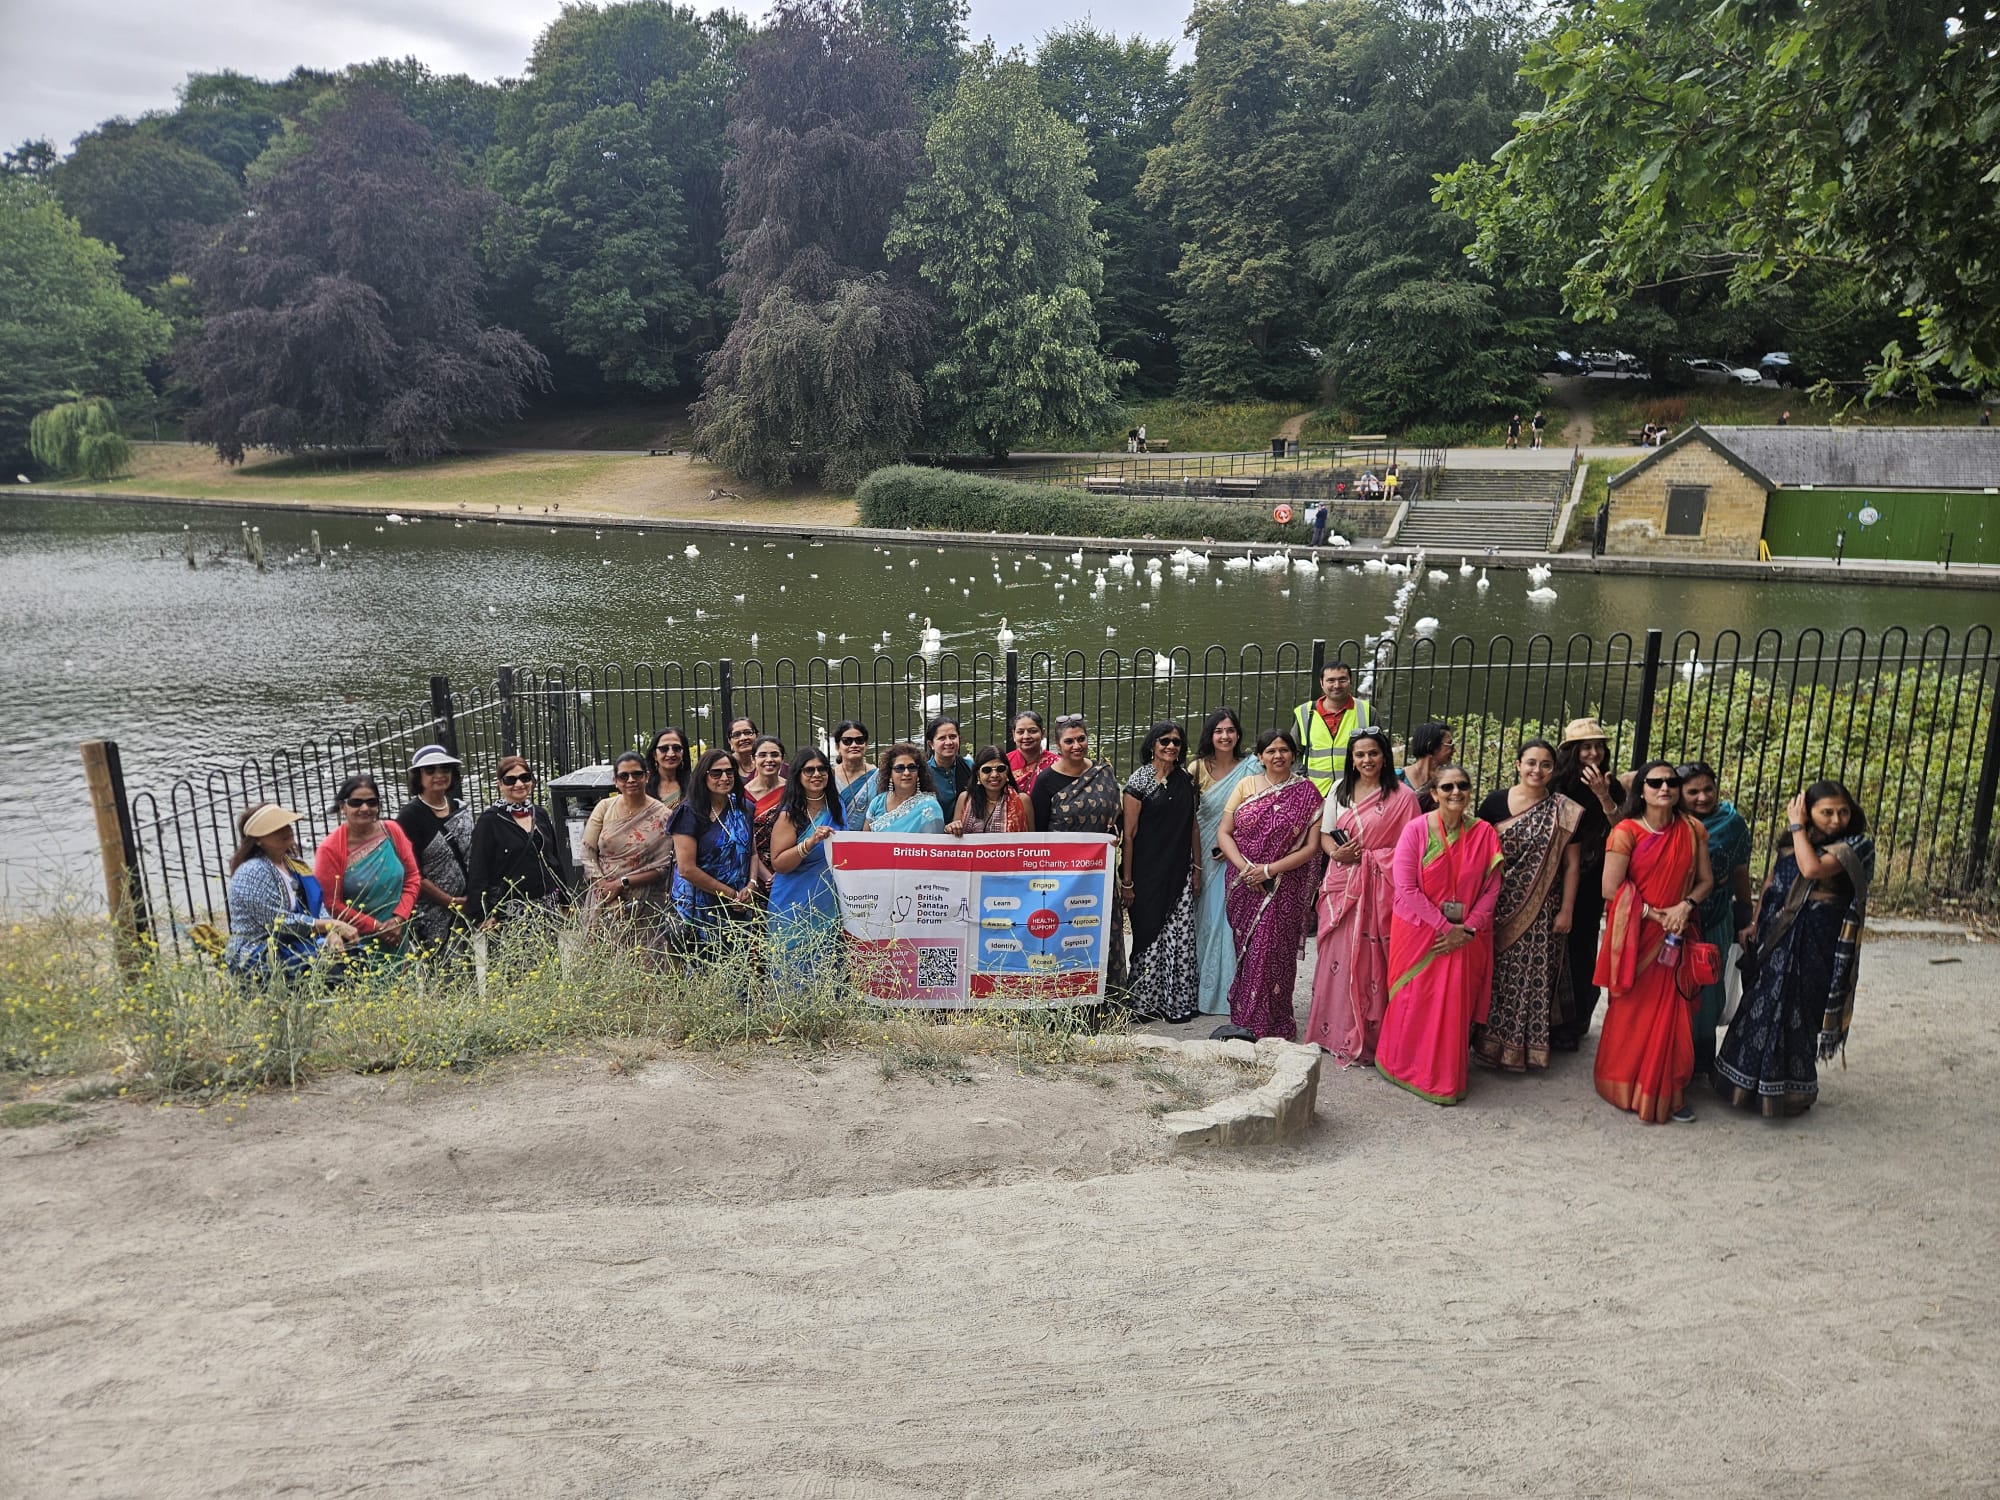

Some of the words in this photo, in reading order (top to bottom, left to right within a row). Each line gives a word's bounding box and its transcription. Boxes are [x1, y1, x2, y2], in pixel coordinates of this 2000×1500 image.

[893, 847, 928, 857] British
[930, 848, 974, 859] Sanatan
[975, 849, 1016, 859] Doctors
[1017, 847, 1051, 857] Forum
[1022, 860, 1038, 869] Reg
[1039, 859, 1069, 869] Charity:
[917, 893, 943, 901] British
[917, 901, 949, 910] Sanatan
[917, 909, 948, 917] Doctors
[991, 942, 1017, 950] Identify
